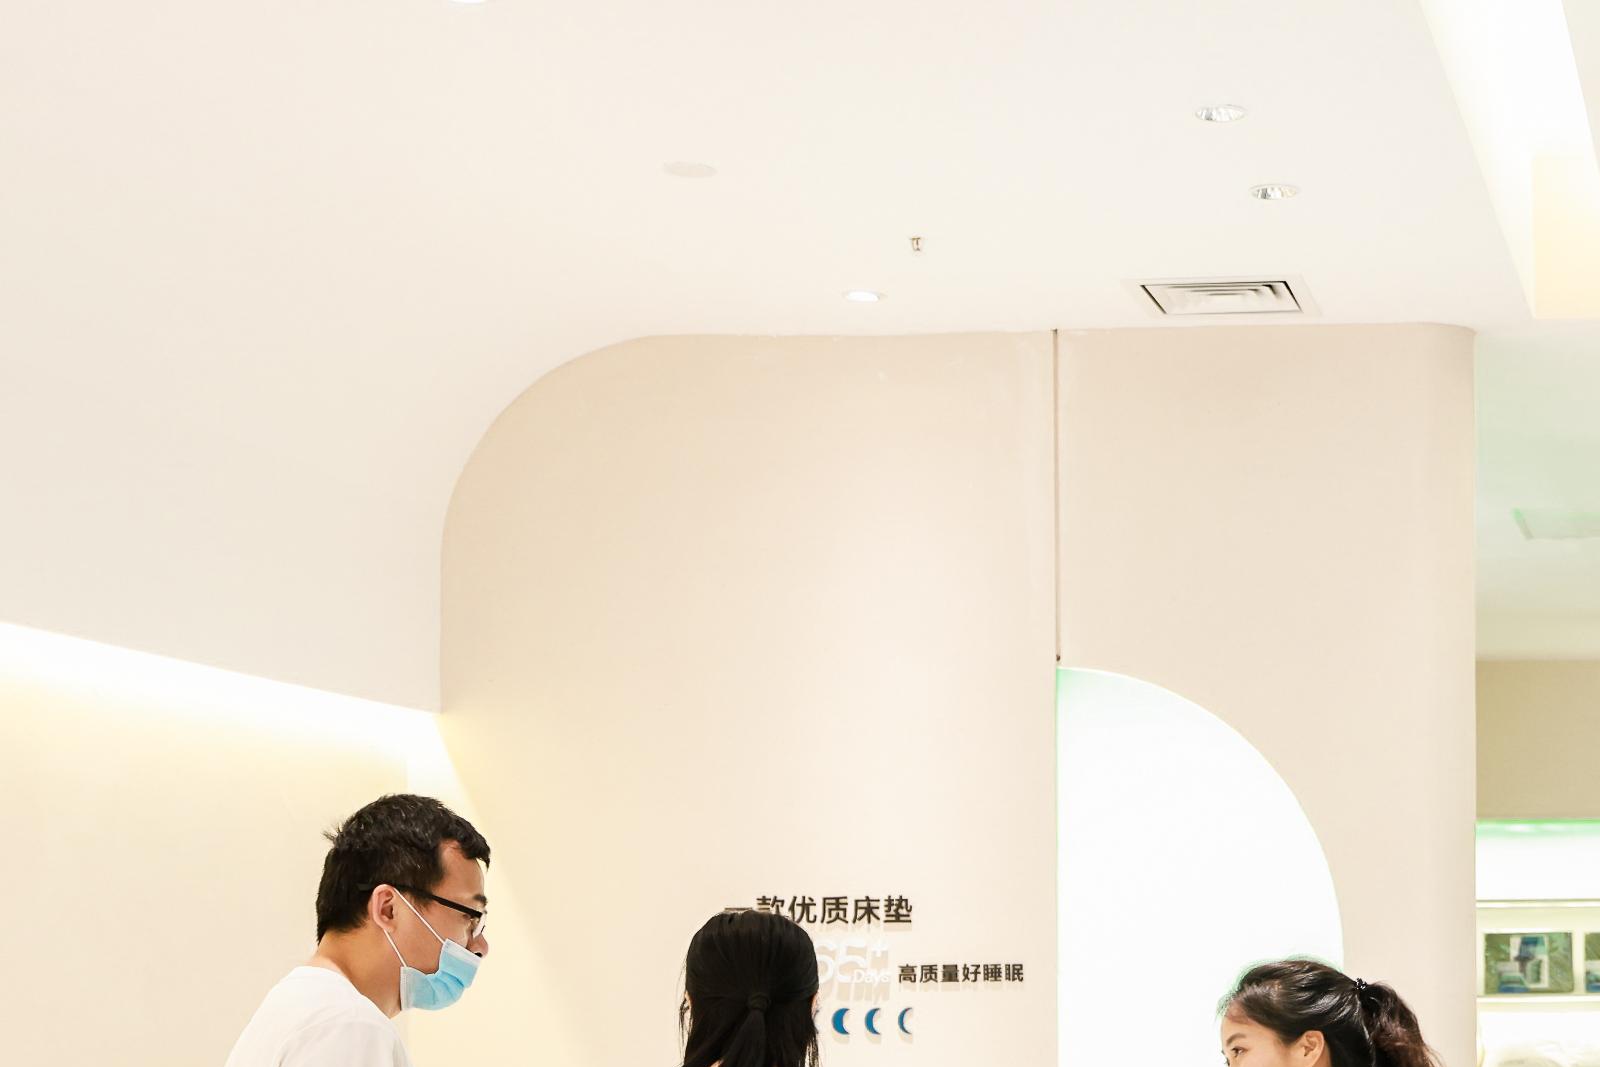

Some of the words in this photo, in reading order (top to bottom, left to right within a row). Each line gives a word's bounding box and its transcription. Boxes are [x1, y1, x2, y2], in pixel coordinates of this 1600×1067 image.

[898, 964, 1025, 983] 高质量好睡眠
